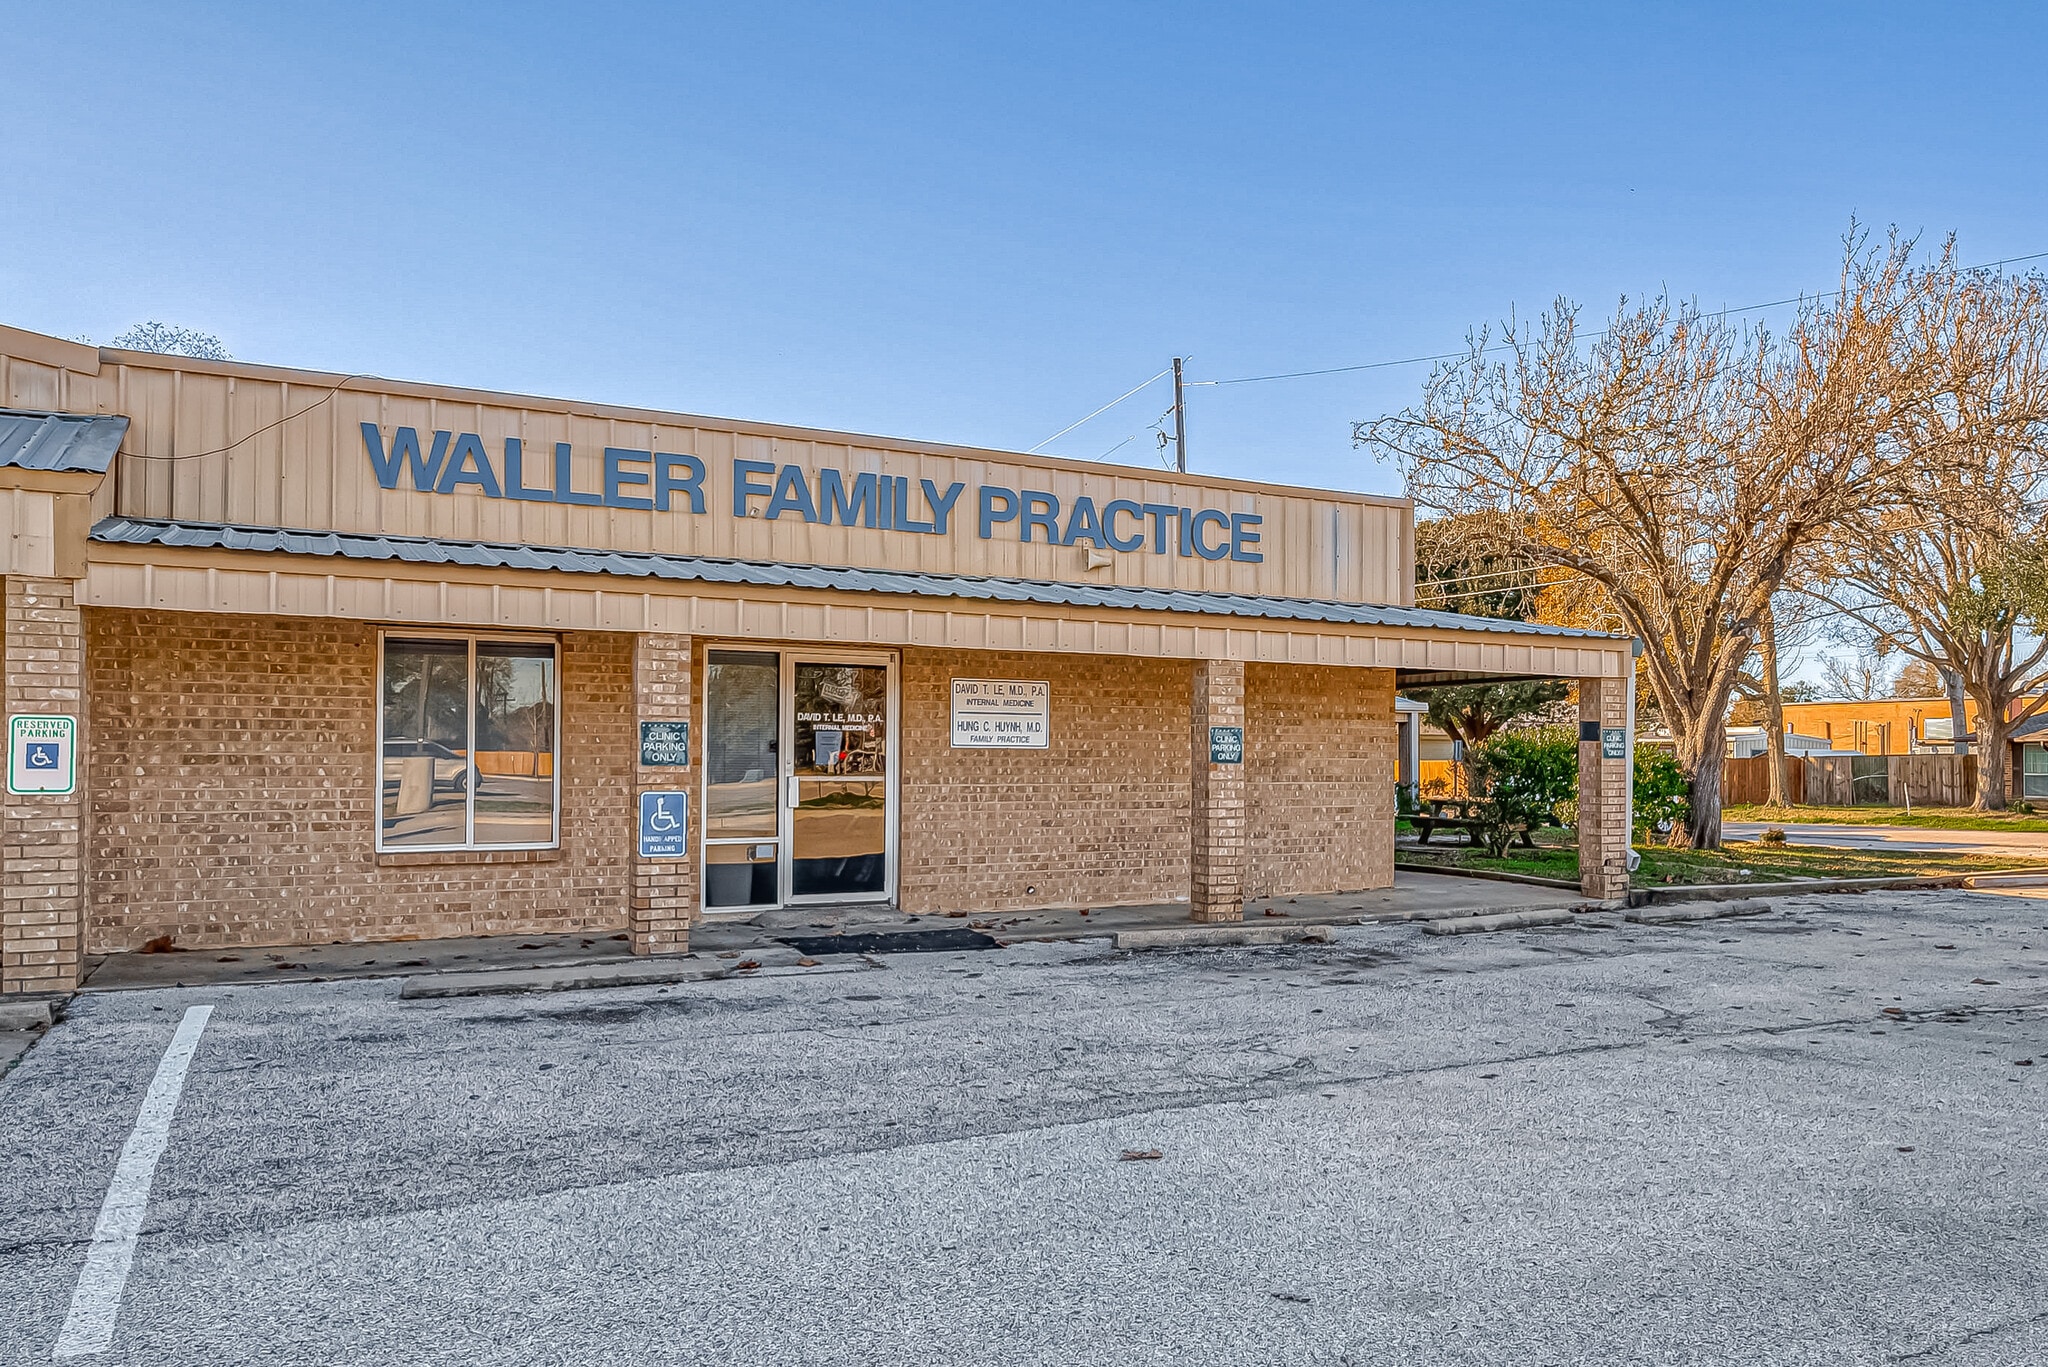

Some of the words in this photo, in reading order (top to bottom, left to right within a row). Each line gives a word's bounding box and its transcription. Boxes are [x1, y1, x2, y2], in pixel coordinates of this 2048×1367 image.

[360, 422, 706, 514] WALLER
[733, 458, 965, 535] FAMILY
[980, 485, 1263, 563] PRACTICE
[955, 683, 979, 694] DAVID
[983, 684, 989, 695] T.
[994, 685, 1005, 696] LE,
[1009, 685, 1027, 697] M.D.,
[1031, 685, 1045, 696] P.A.
[966, 698, 999, 706] INTERNAL
[1003, 699, 1034, 707] MEDICINE
[797, 712, 821, 721] DAVID
[823, 713, 831, 722] T.
[832, 713, 845, 723] LE,
[17, 720, 69, 730] RESERVED
[957, 720, 979, 732] HUNG
[983, 721, 991, 732] C.
[995, 721, 1022, 734] HUYNH,
[1026, 721, 1043, 733] M.D.
[20, 729, 66, 738] PARKING
[648, 731, 681, 741] CLINIC
[970, 735, 993, 743] FAMILY
[997, 735, 1031, 744] PRACTICE
[1215, 735, 1238, 743] CLINIC
[643, 742, 686, 752] PARKING
[1212, 744, 1241, 752] PARKING
[651, 752, 678, 762] ONLY
[1217, 752, 1236, 760] ONLY
[643, 835, 683, 843] HANDIAPPED
[649, 844, 676, 853] PARKING
